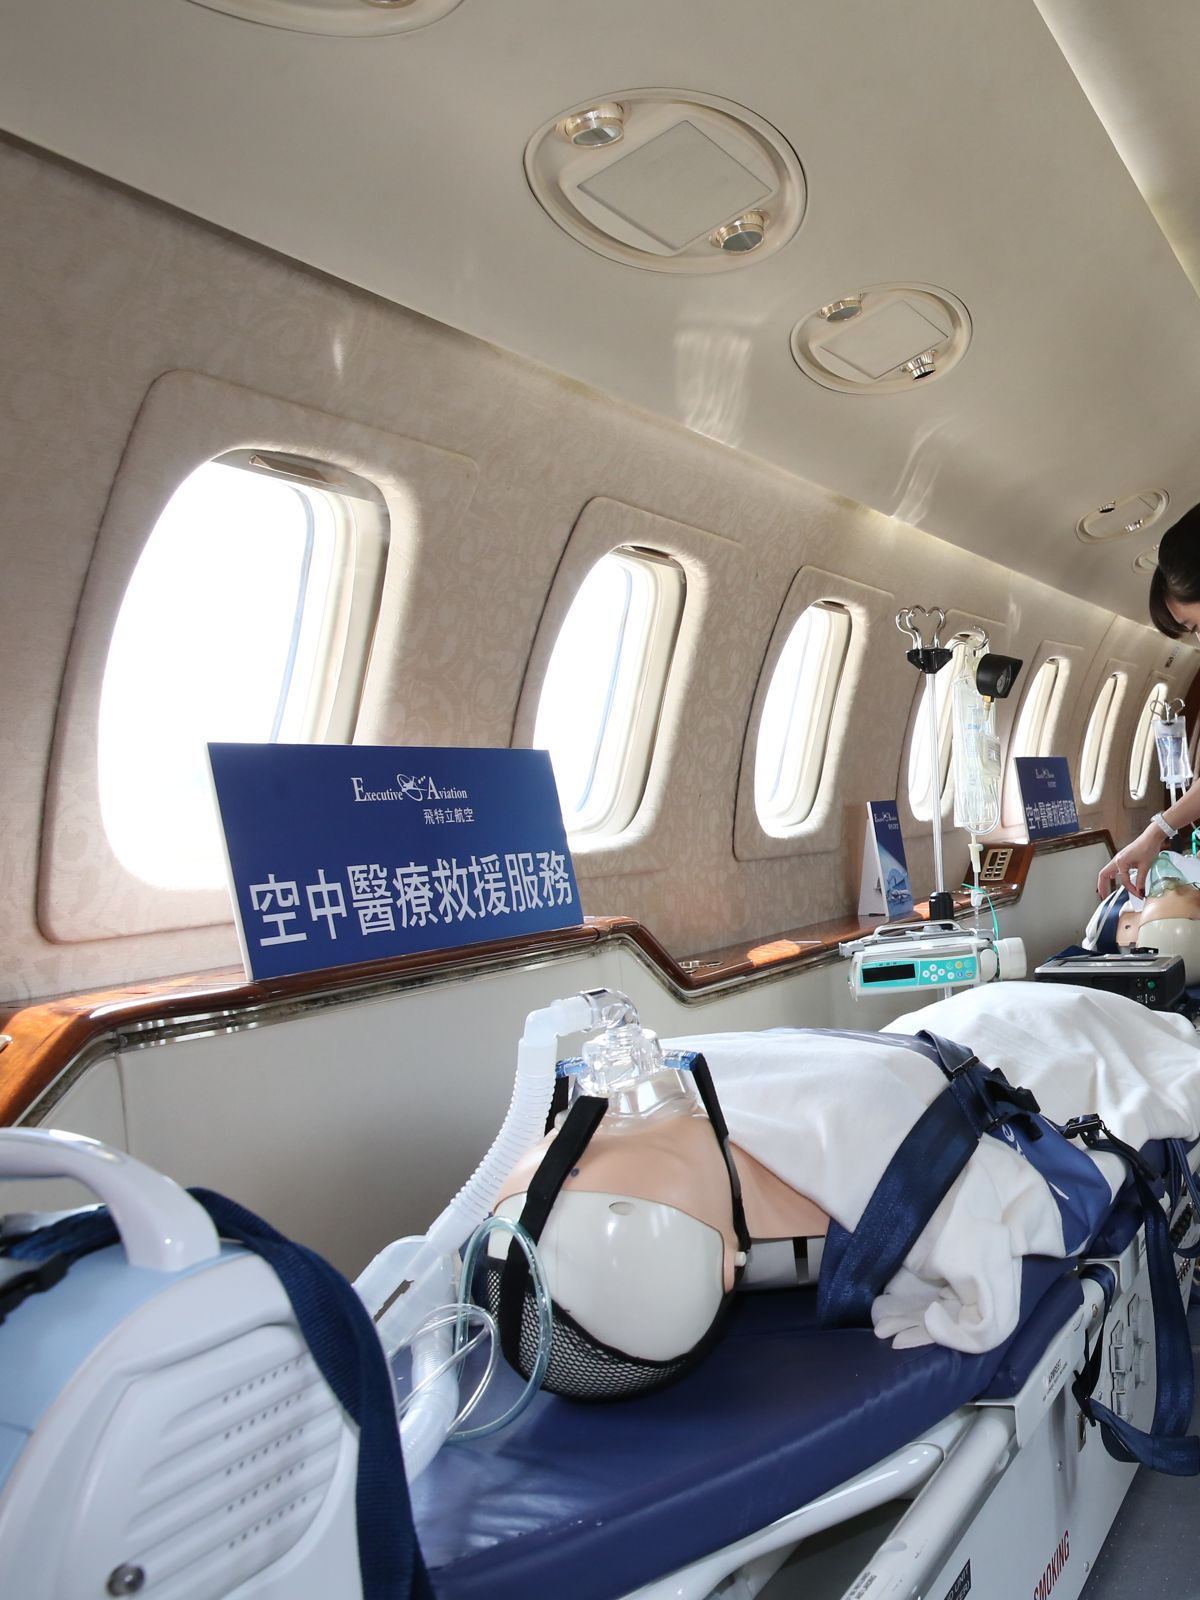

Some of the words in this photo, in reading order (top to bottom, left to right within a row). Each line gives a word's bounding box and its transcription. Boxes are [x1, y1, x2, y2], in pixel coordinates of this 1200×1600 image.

[351, 777, 403, 802] Executive
[427, 776, 468, 800] Aviation
[423, 808, 475, 825] 飛特立航空
[249, 850, 573, 948] 空中醫療救援服務
